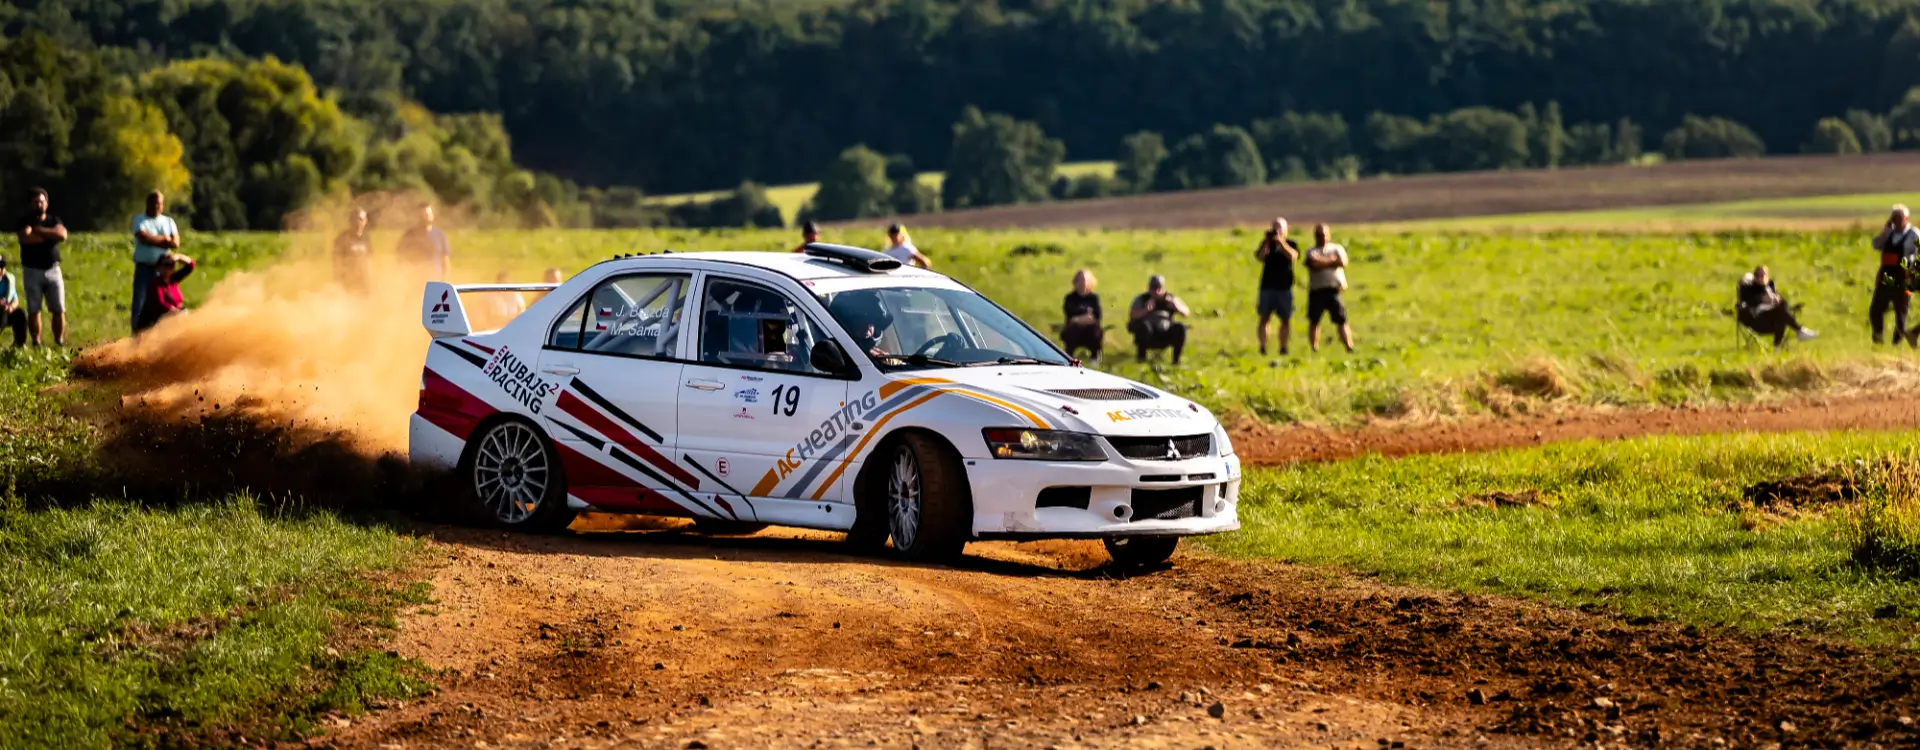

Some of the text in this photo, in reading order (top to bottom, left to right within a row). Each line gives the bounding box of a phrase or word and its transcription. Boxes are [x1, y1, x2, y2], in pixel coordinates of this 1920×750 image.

[483, 345, 508, 375] team
[488, 364, 542, 415] RACING
[771, 383, 800, 417] 19
[718, 460, 728, 475] E
